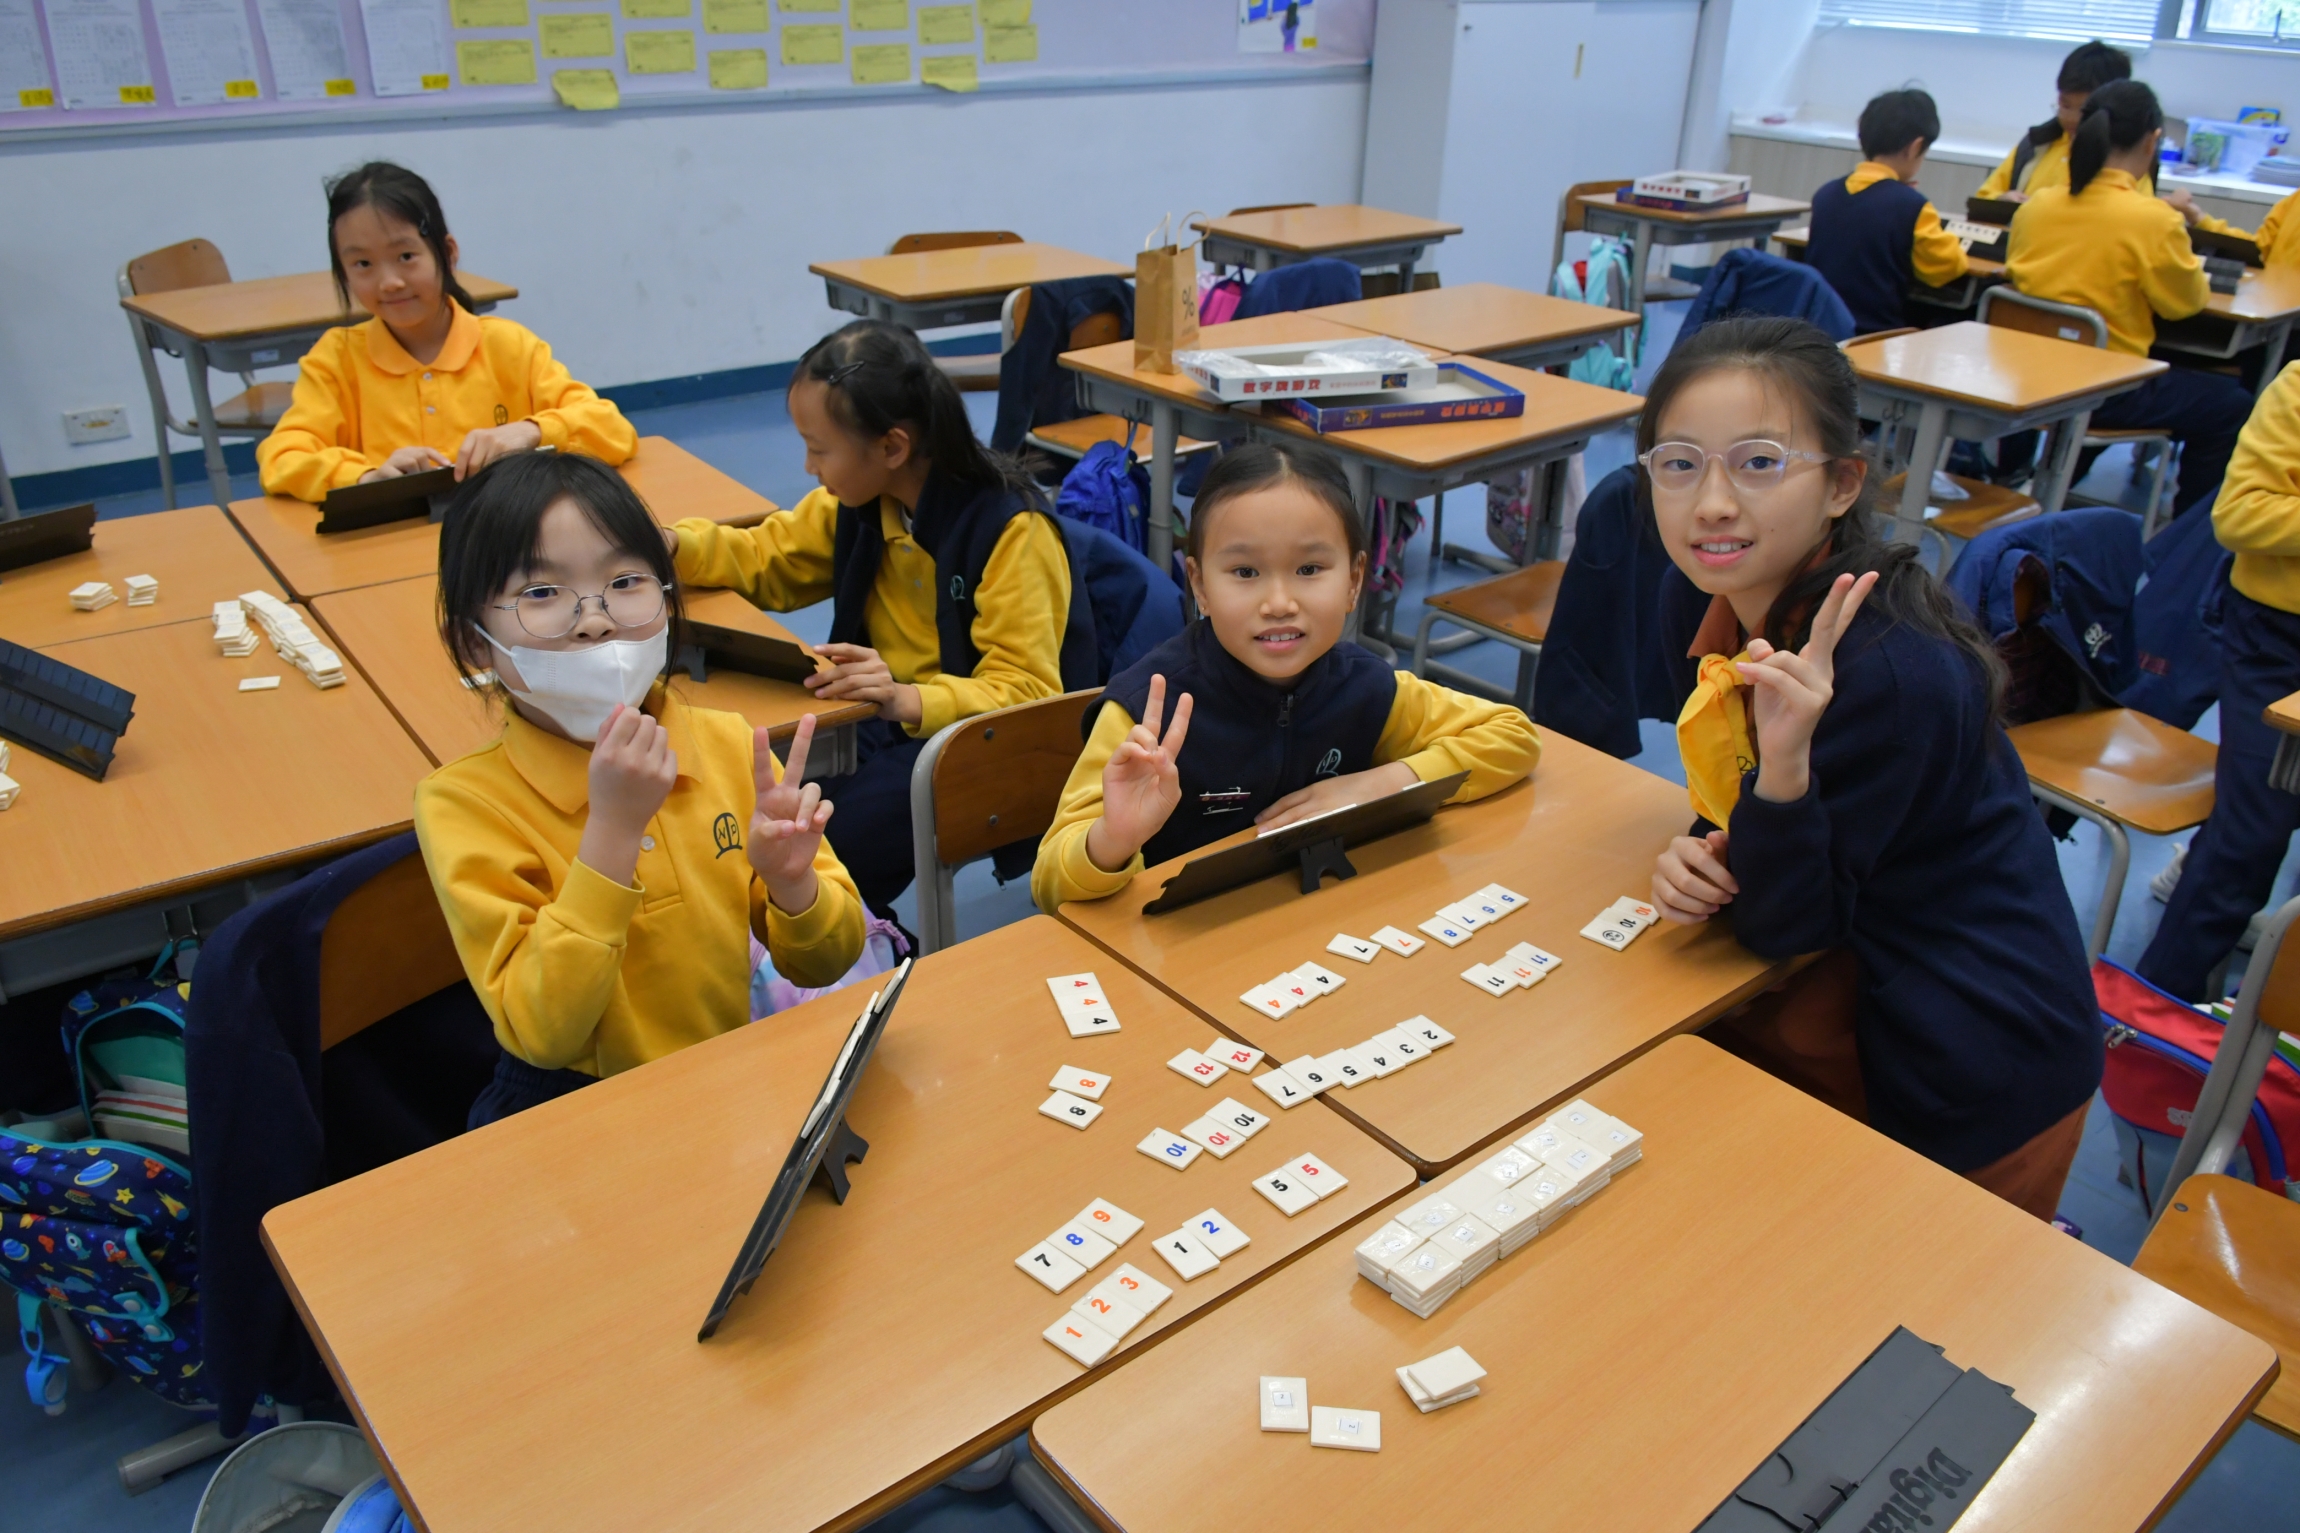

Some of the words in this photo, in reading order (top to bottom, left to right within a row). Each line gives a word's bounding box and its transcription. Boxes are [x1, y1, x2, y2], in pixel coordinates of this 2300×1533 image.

[1501, 894, 1515, 903] 5
[1635, 906, 1652, 916] 10
[1462, 916, 1476, 924] 7
[1619, 918, 1637, 928] 10
[1443, 929, 1458, 938] 8
[1398, 939, 1411, 947] 7
[1354, 945, 1369, 954] 7
[1531, 954, 1548, 965] 11
[1514, 968, 1531, 979] 11
[1073, 980, 1089, 988] 4
[1316, 975, 1329, 984] 4
[1487, 976, 1505, 987] 11
[1290, 986, 1305, 996] 4
[1083, 998, 1098, 1006] 4
[1267, 999, 1281, 1009] 4
[1092, 1017, 1108, 1025] 4
[1422, 1030, 1438, 1040] 2
[1399, 1043, 1415, 1054] 3
[1231, 1051, 1251, 1063] 12
[1373, 1056, 1387, 1067] 4
[1193, 1062, 1214, 1076] 13
[1342, 1065, 1358, 1077] 5
[1079, 1078, 1097, 1088] 8
[1307, 1072, 1323, 1083] 6
[1282, 1085, 1297, 1097] 7
[1069, 1106, 1087, 1116] 8
[1234, 1113, 1255, 1127] 10
[1208, 1132, 1230, 1146] 10
[1166, 1143, 1187, 1157] 10
[1270, 1179, 1289, 1192] 5
[1301, 1163, 1320, 1176] 5
[1034, 1253, 1052, 1267] 7
[1065, 1233, 1084, 1246] 8
[1092, 1209, 1112, 1223] 9
[1173, 1241, 1188, 1254] 1
[1201, 1220, 1221, 1235] 2
[1065, 1326, 1083, 1339] 1
[1090, 1298, 1112, 1314] 2
[1119, 1276, 1139, 1291] 3
